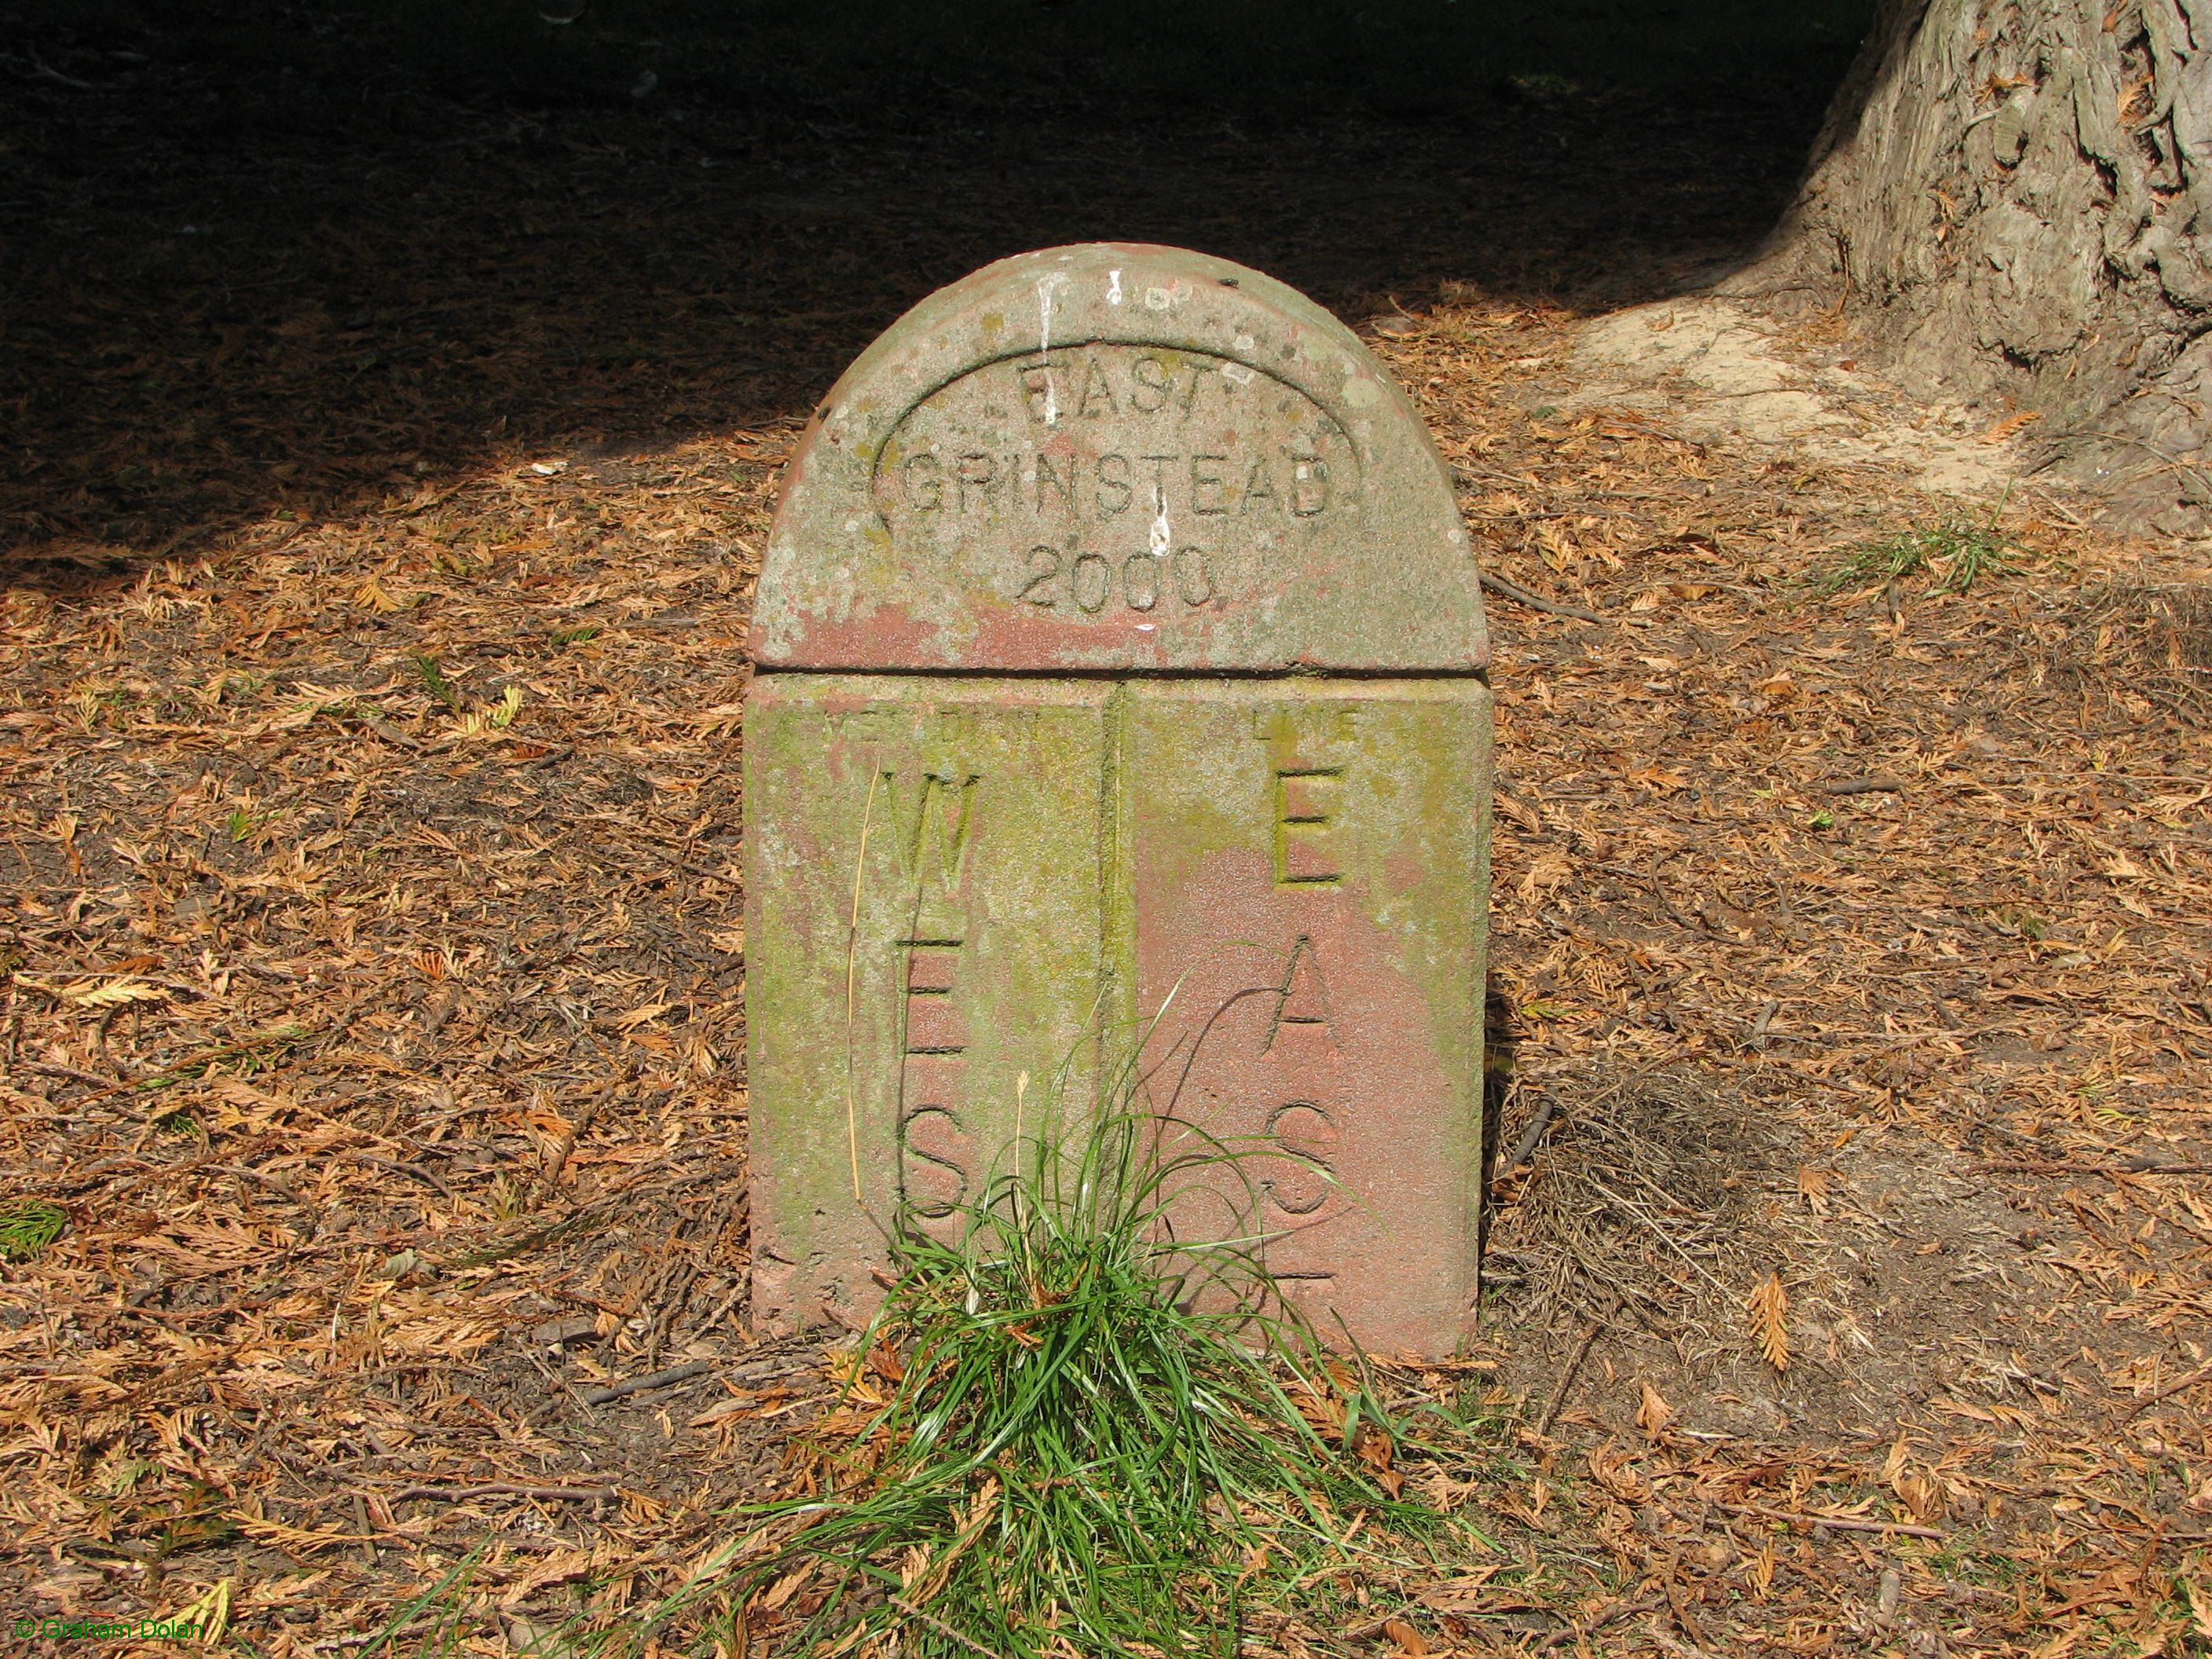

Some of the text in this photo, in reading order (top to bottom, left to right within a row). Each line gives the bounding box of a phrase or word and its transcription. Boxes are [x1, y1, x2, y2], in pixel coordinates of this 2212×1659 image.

[1016, 357, 1219, 425] EAST
[903, 452, 1331, 518] GRINSTEAD
[1017, 545, 1216, 613] 2000
[878, 771, 982, 1219] WES
